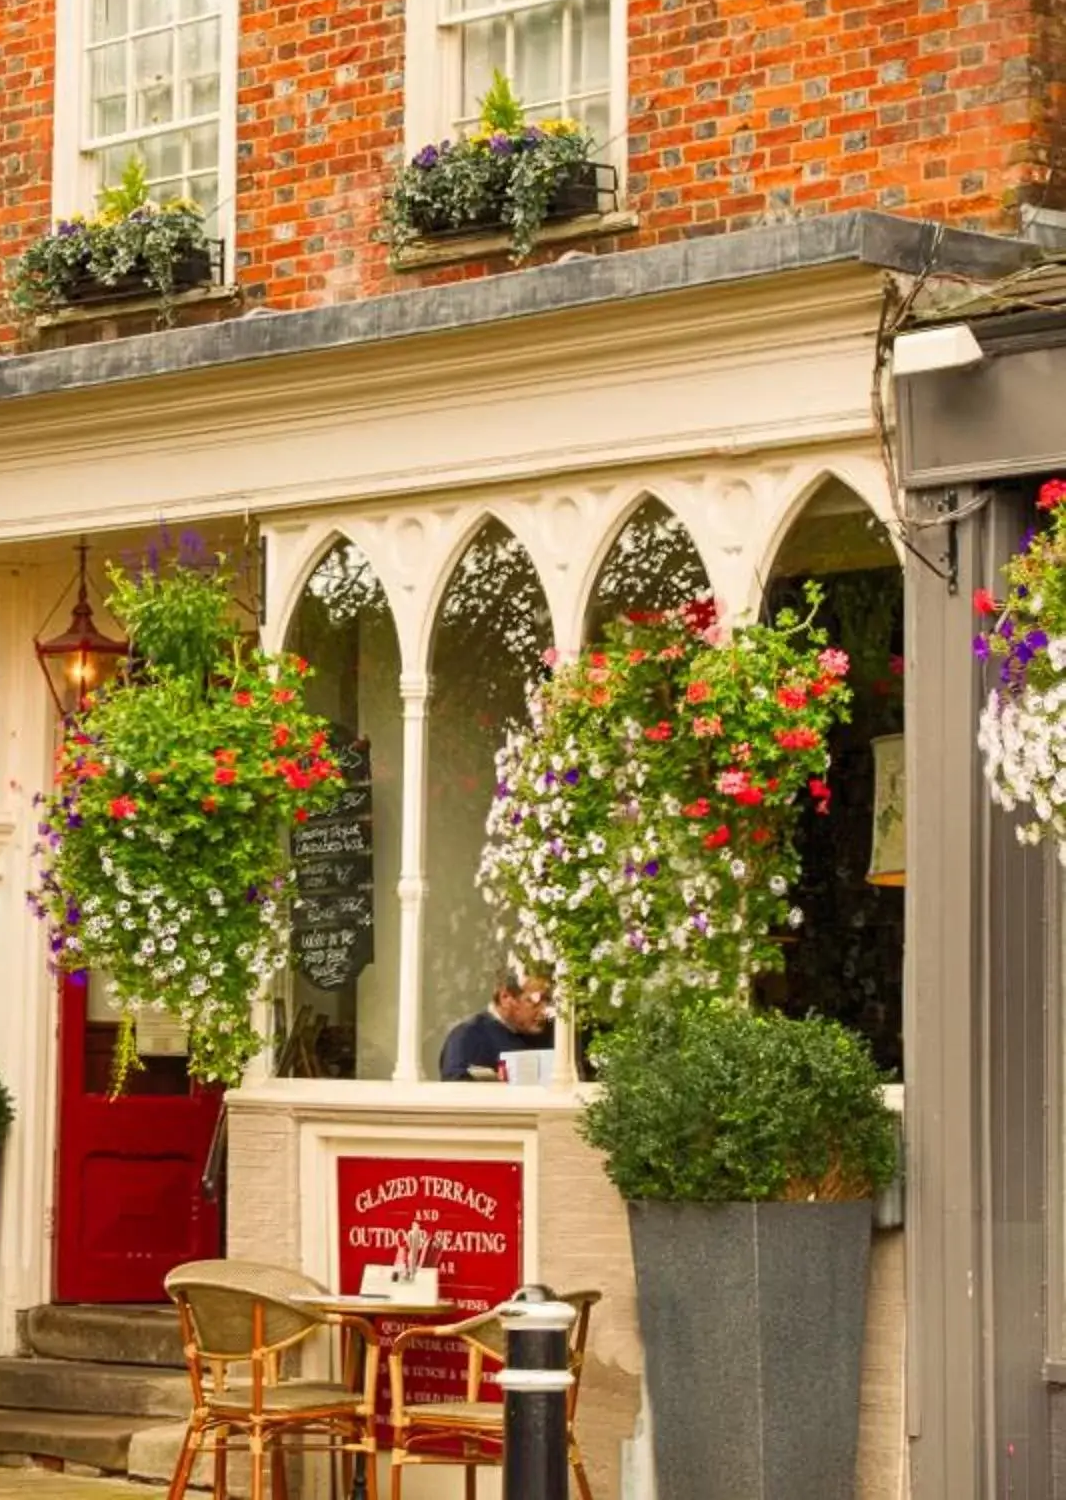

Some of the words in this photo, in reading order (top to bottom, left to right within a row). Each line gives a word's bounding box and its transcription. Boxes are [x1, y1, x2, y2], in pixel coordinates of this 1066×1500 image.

[355, 1176, 418, 1213] GLAZED
[420, 1175, 498, 1221] TERRACE
[415, 1209, 440, 1221] AND
[433, 1229, 507, 1253] SEATING
